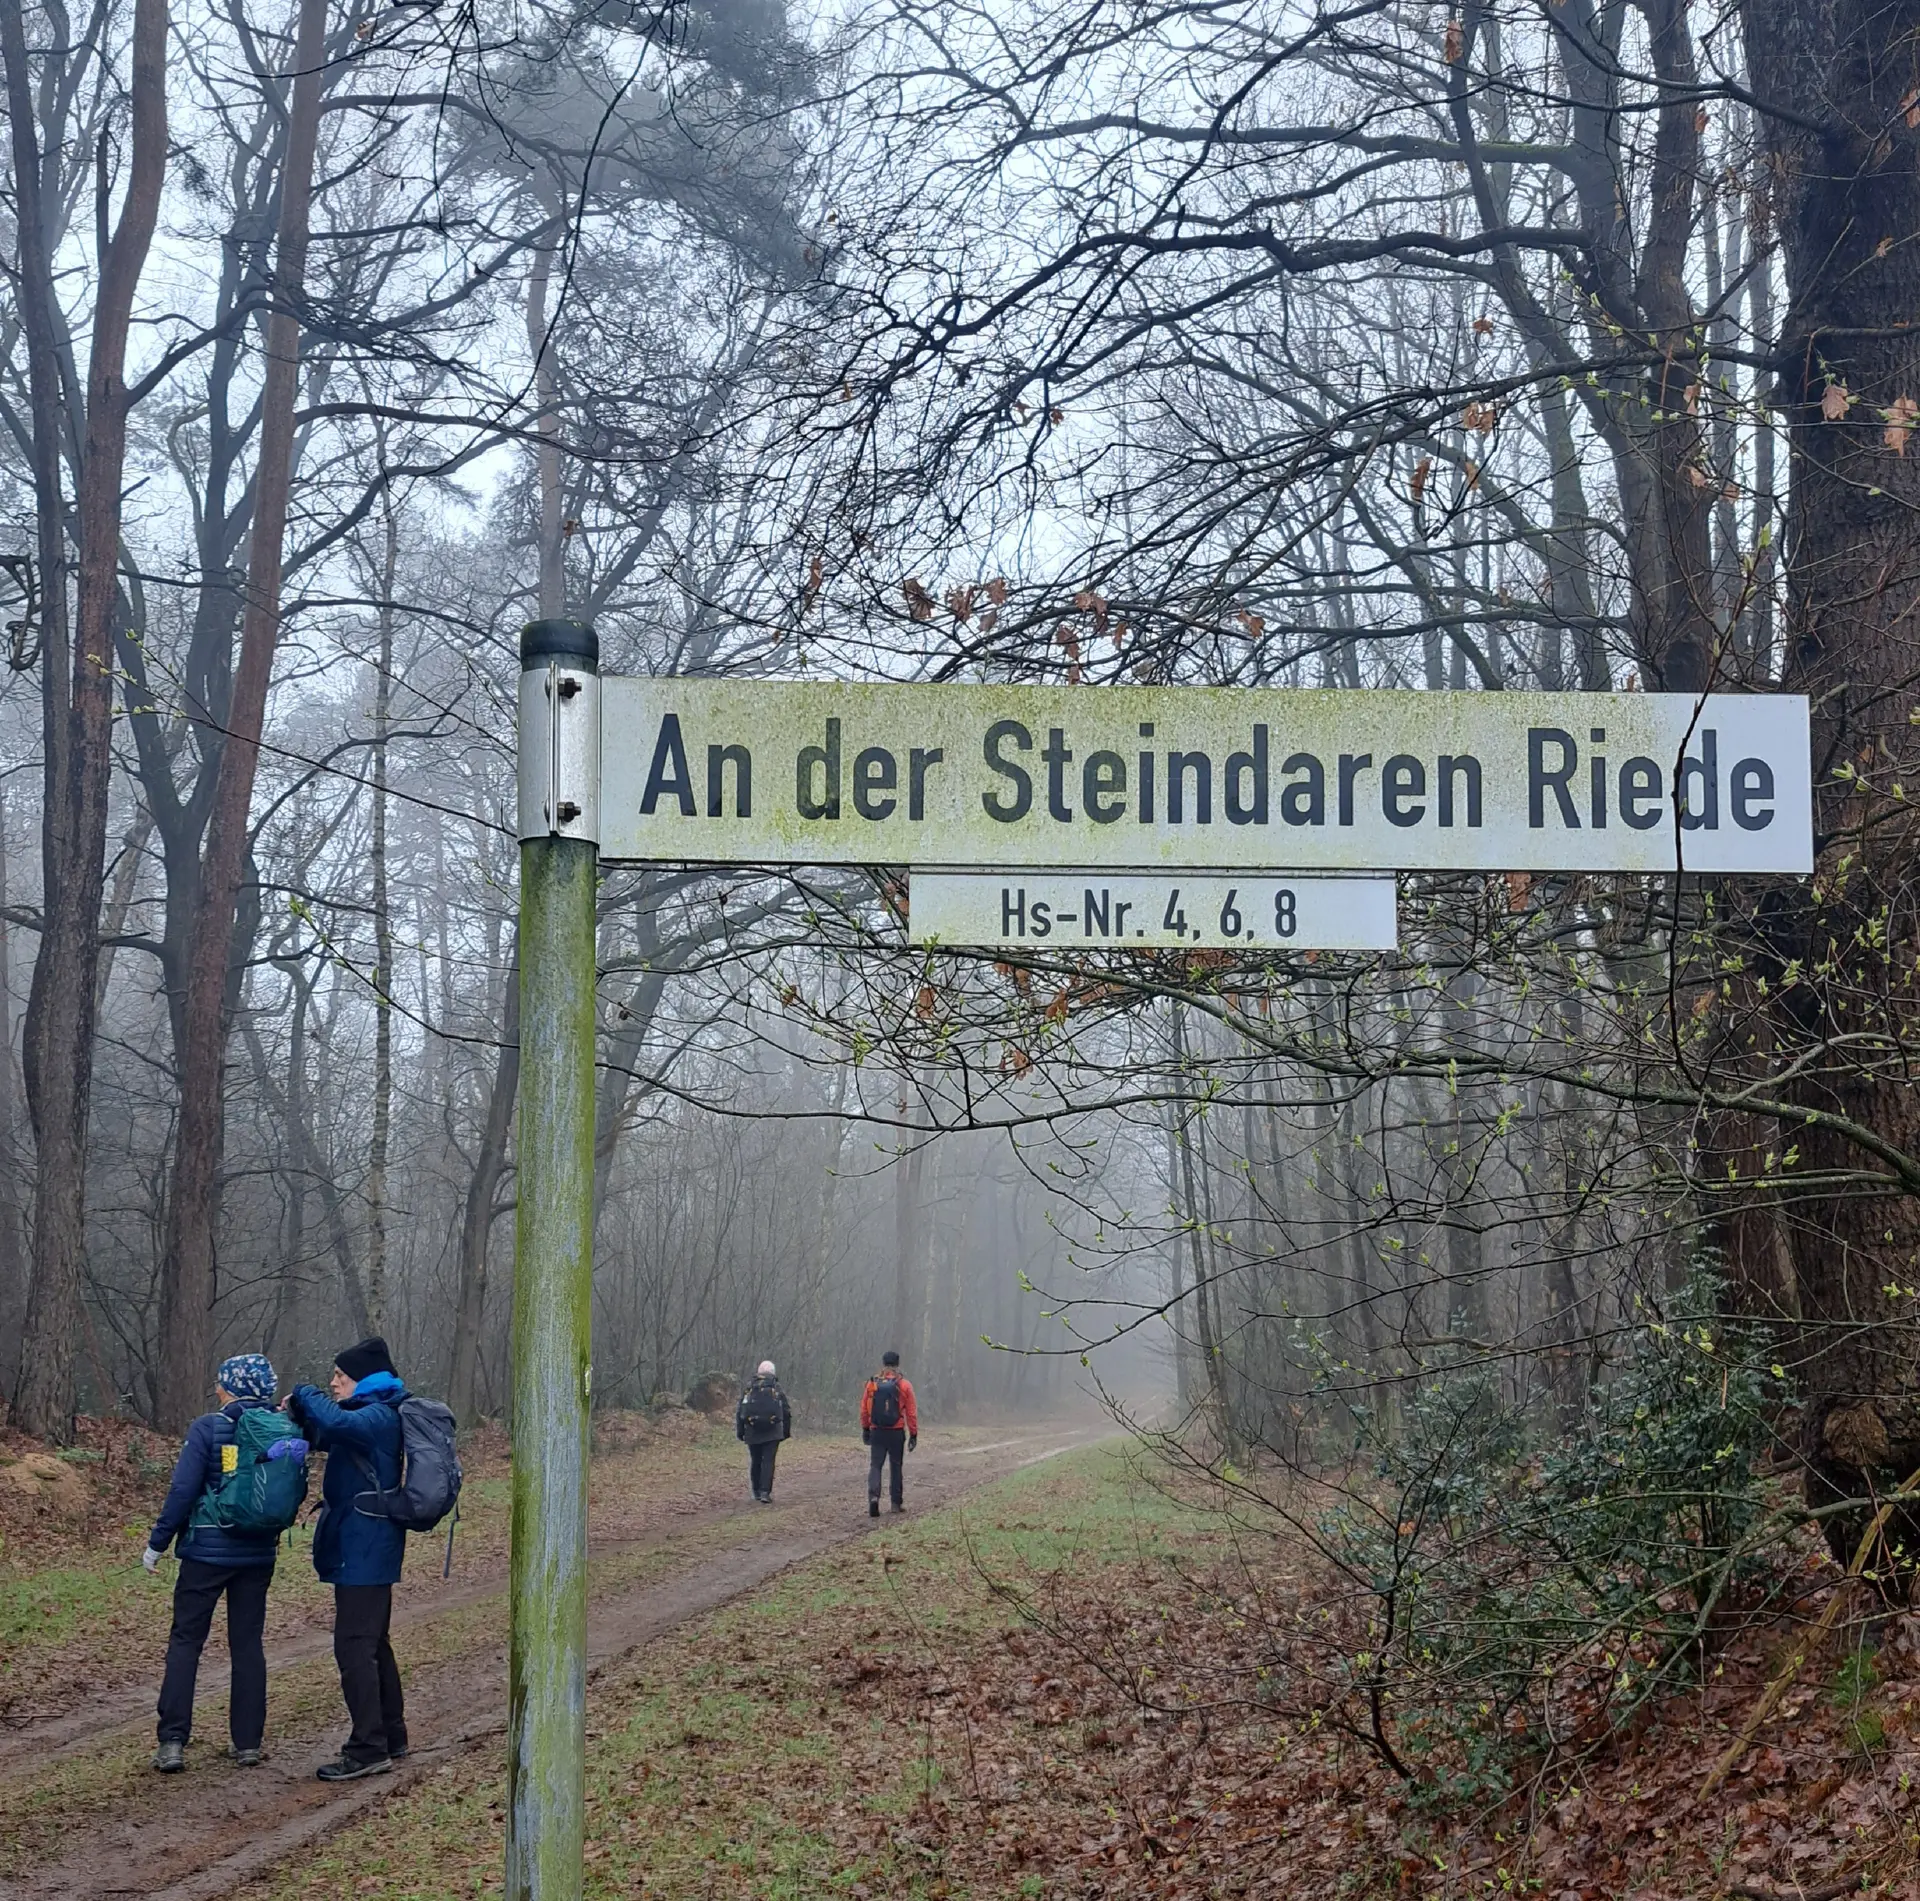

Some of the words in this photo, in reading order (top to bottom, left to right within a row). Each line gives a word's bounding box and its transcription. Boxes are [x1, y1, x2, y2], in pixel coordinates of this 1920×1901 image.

[638, 713, 752, 818] An
[796, 717, 944, 822] der
[982, 719, 1483, 828] Steindaren
[1527, 727, 1775, 831] Riede
[1001, 888, 1144, 938] Hs-Nr.
[1163, 889, 1201, 941] 4,
[1220, 889, 1254, 941] 6,
[1274, 889, 1297, 938] 8
